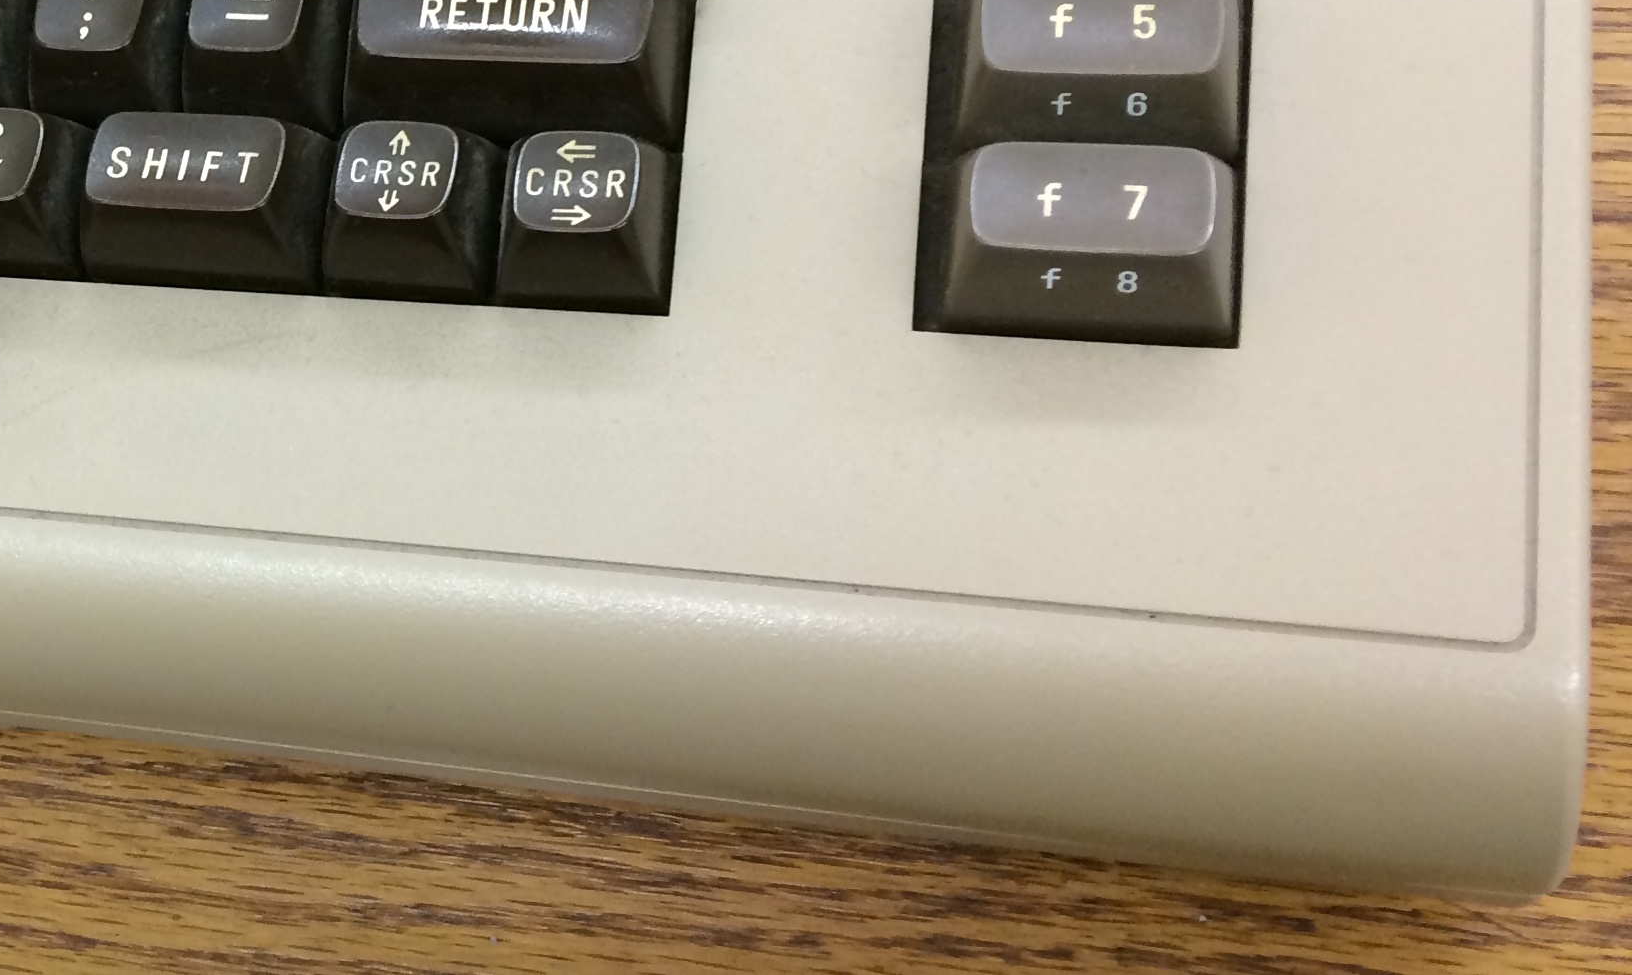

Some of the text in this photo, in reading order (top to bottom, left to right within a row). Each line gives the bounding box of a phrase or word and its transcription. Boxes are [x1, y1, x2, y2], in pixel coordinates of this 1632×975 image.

[106, 146, 259, 183] SHIFT
[350, 157, 440, 187] CRSR
[525, 167, 626, 199] CRSR
